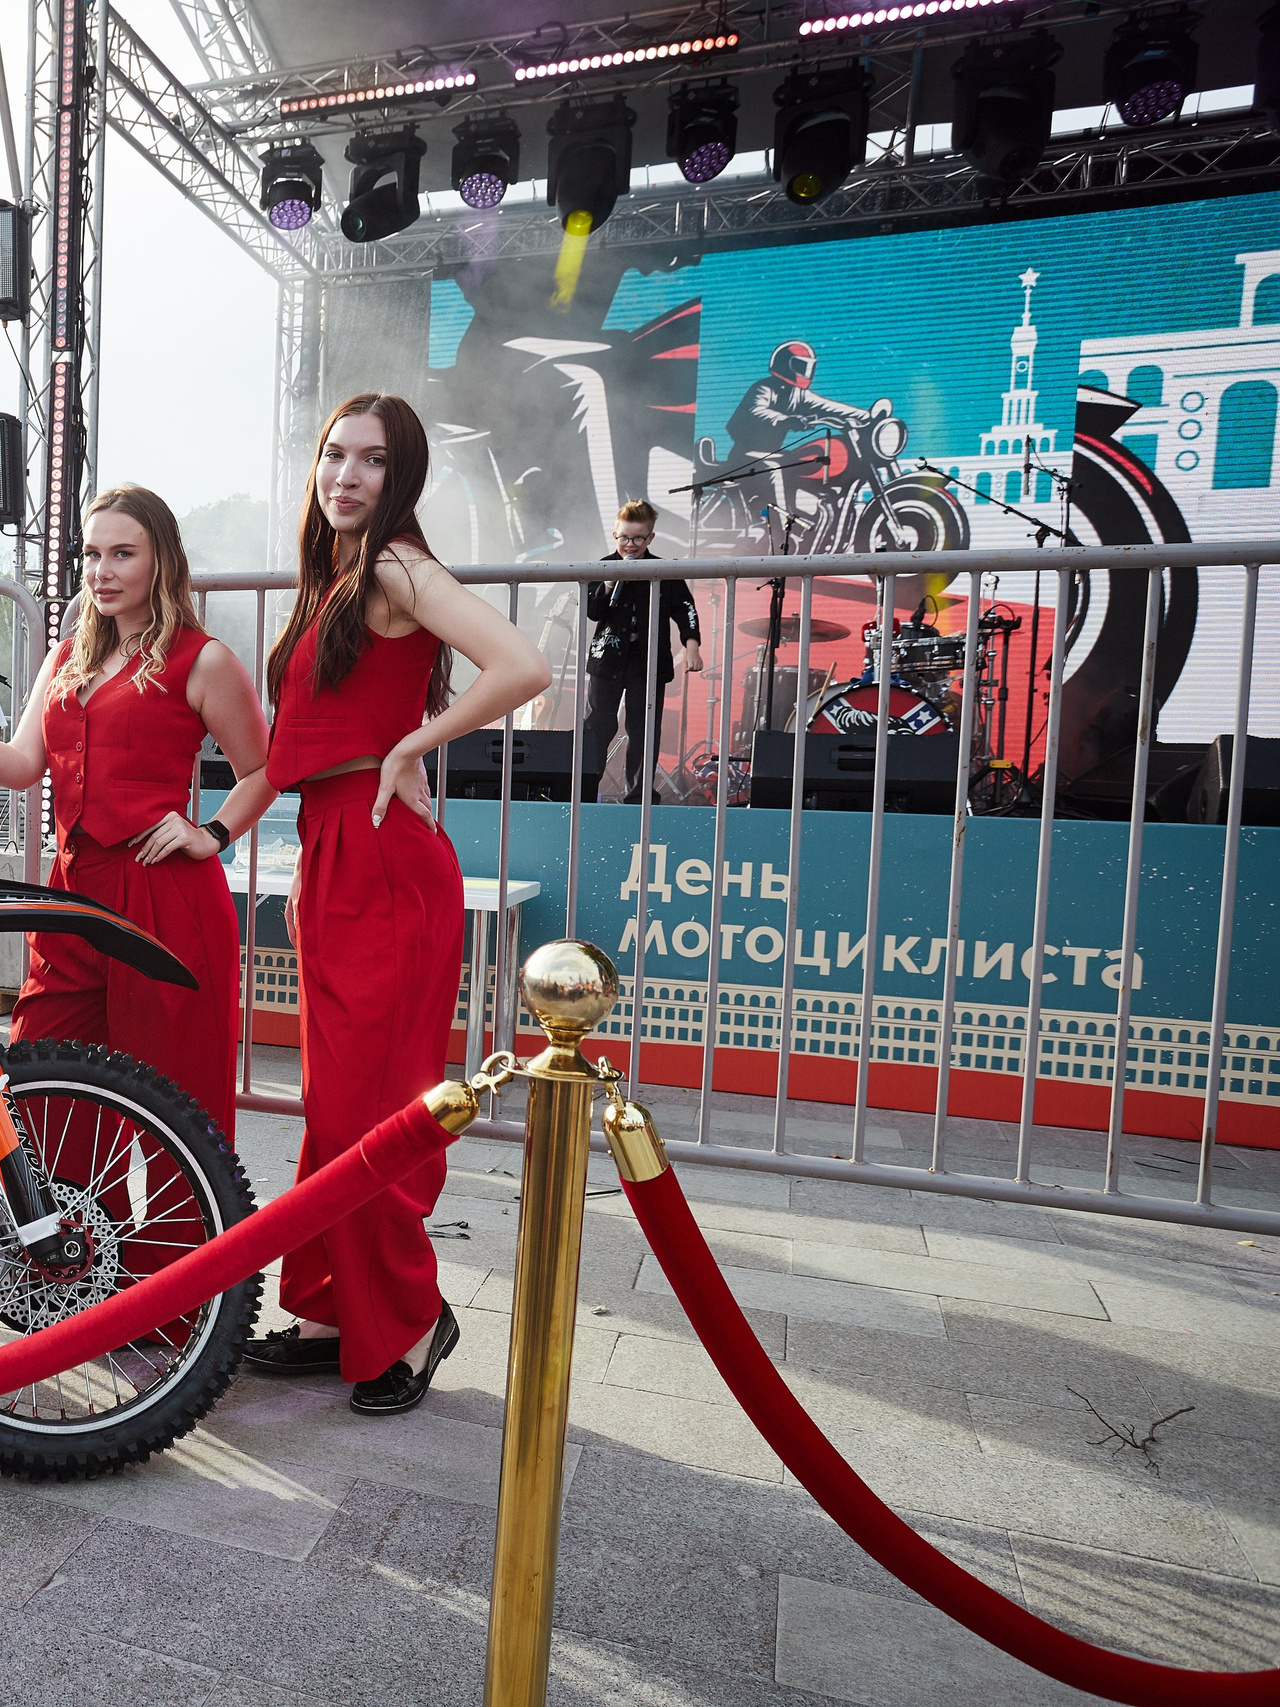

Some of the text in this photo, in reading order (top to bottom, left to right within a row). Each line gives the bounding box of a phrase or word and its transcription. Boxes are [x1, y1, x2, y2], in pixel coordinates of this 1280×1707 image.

[620, 843, 790, 903] День
[618, 918, 1143, 990] мотоциклиста
[1, 1091, 48, 1190] KENDA
